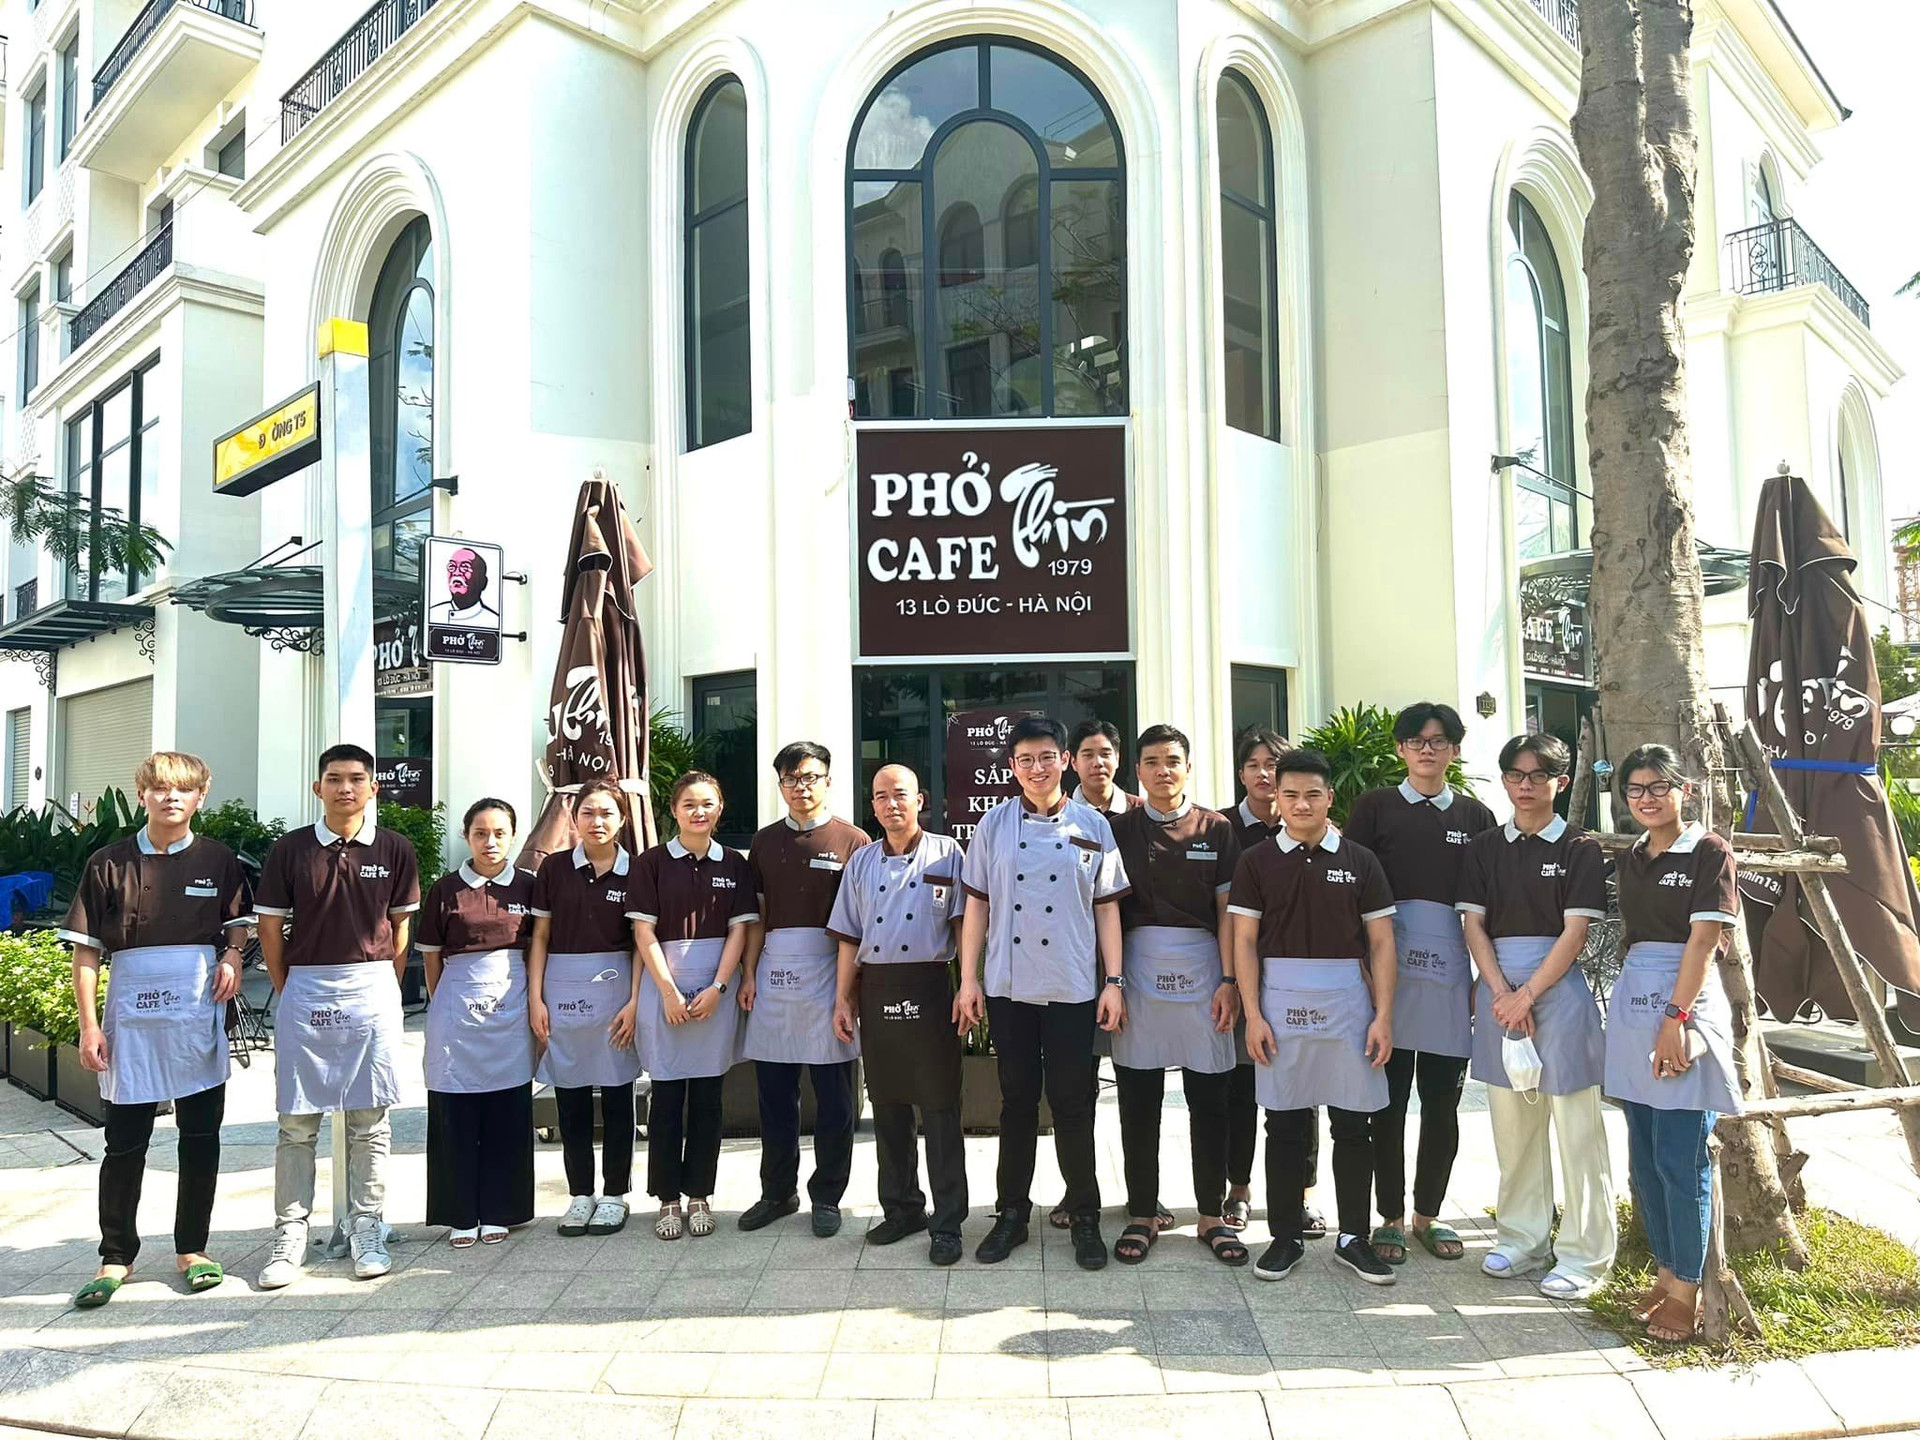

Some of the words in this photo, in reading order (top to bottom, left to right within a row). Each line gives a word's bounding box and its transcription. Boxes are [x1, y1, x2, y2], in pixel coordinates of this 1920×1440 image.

[293, 410, 306, 430] T5
[870, 451, 992, 517] PHỞ
[867, 536, 999, 582] CAFE
[1048, 558, 1093, 576] 1979
[896, 599, 916, 615] 13
[923, 594, 950, 615] LÒ
[957, 593, 1001, 614] ĐÚC
[1019, 593, 1049, 613] HÀ
[1056, 591, 1092, 616] NỘI
[1523, 616, 1554, 644] AFE
[442, 634, 466, 646] PHỞ
[1828, 706, 1855, 731] 979
[967, 724, 994, 737] PHỞ
[376, 769, 396, 781] HỞ
[974, 763, 1013, 785] SẮP
[1156, 983, 1176, 991] CAFE
[136, 1000, 160, 1009] CAFE
[310, 1018, 332, 1026] CAFE
[1286, 1017, 1308, 1026] CAFE
